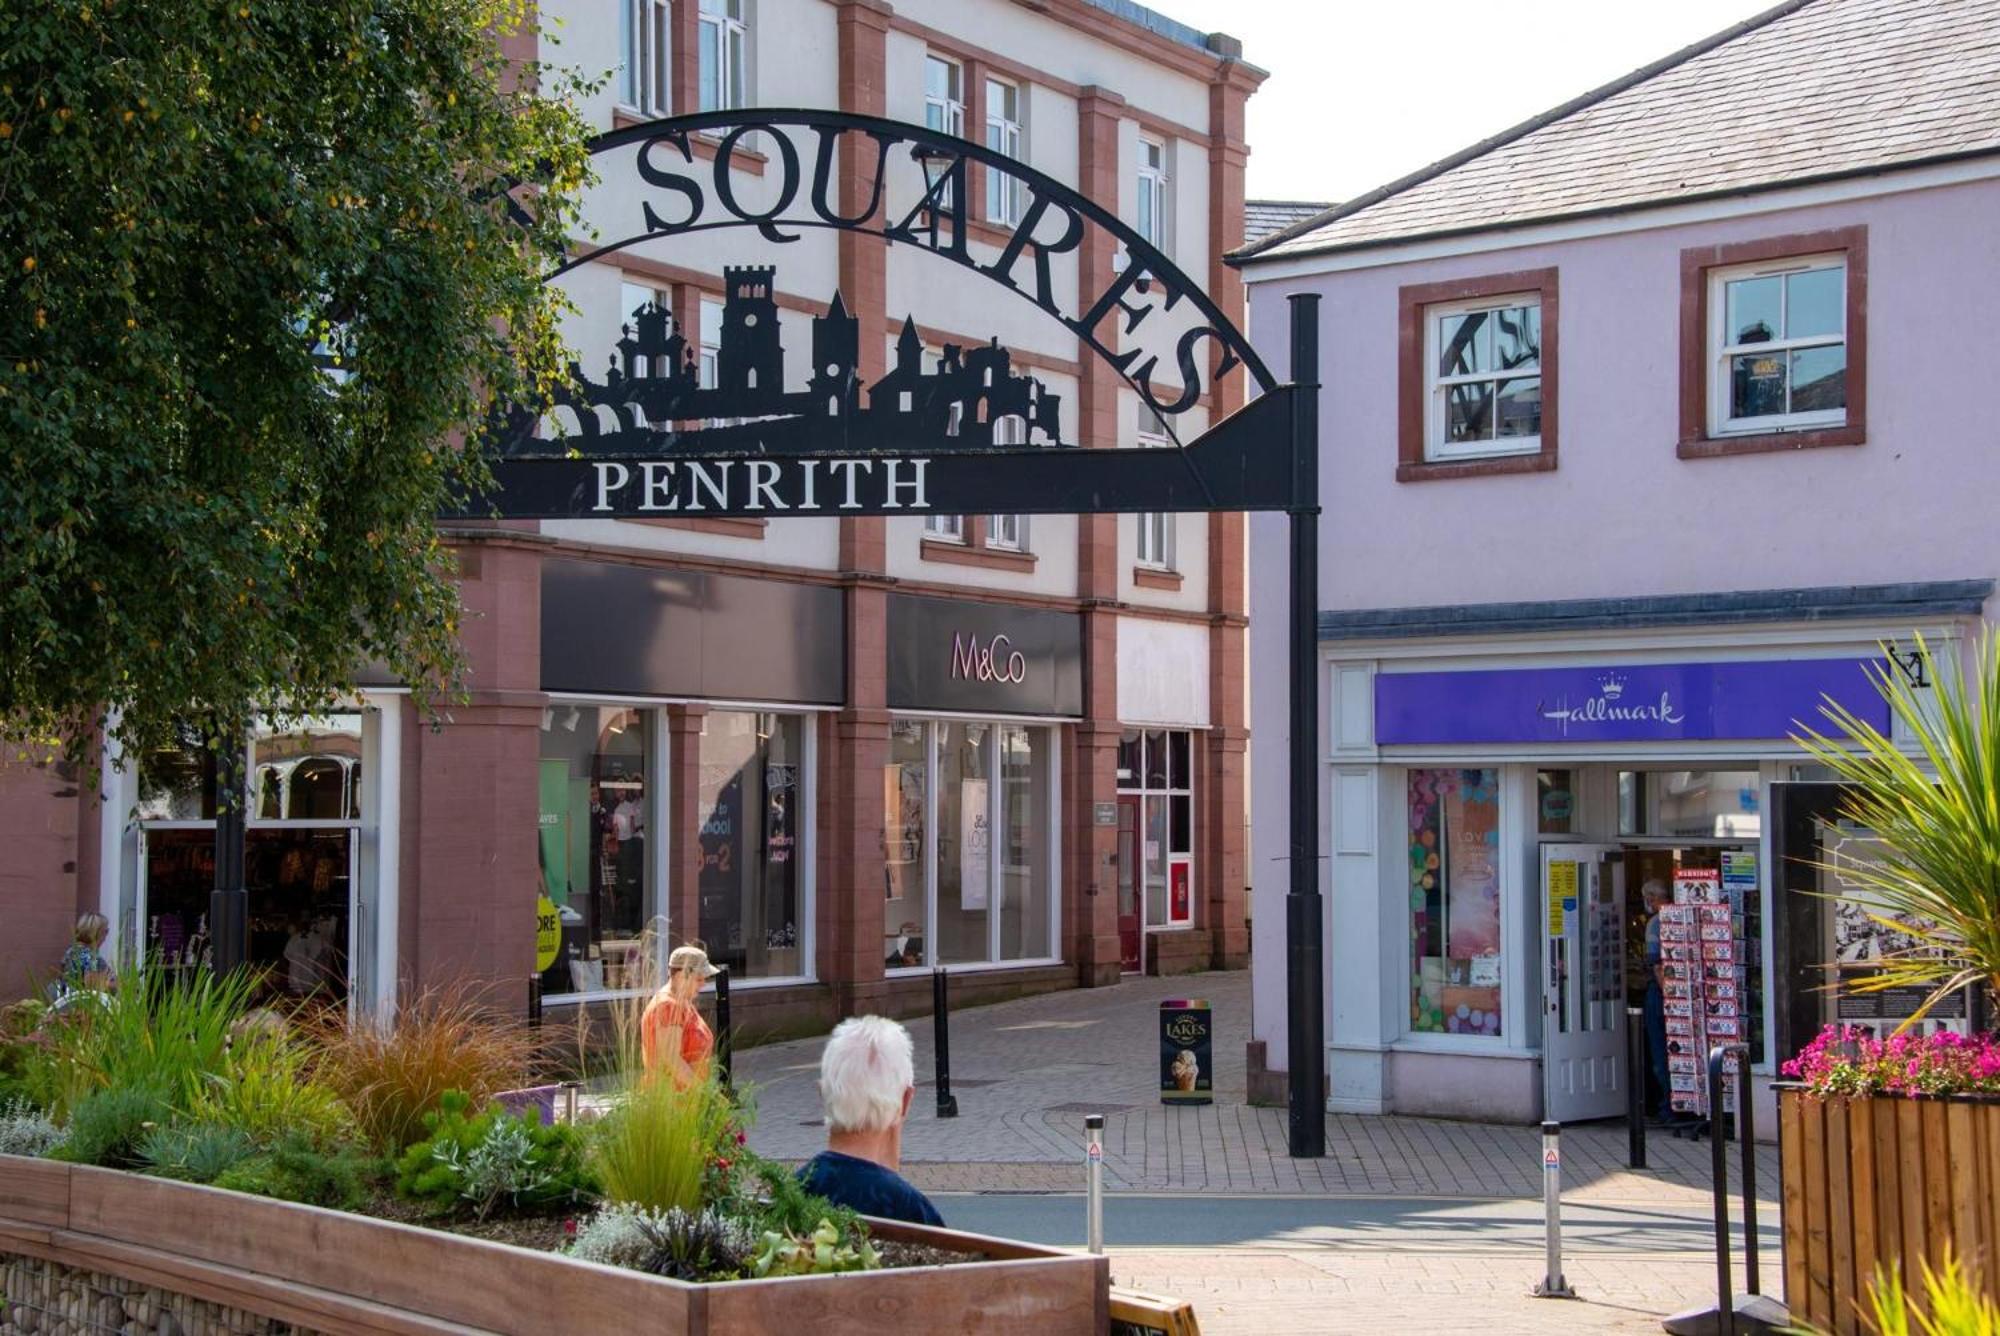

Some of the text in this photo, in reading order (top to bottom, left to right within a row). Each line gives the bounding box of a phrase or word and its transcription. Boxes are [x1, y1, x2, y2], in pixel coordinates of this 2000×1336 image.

[636, 124, 1239, 414] SQUARES
[592, 458, 931, 511] PENRITH
[952, 631, 1025, 683] M&Co
[1543, 691, 1686, 737] Hallmark
[1166, 1023, 1207, 1038] LAKES
